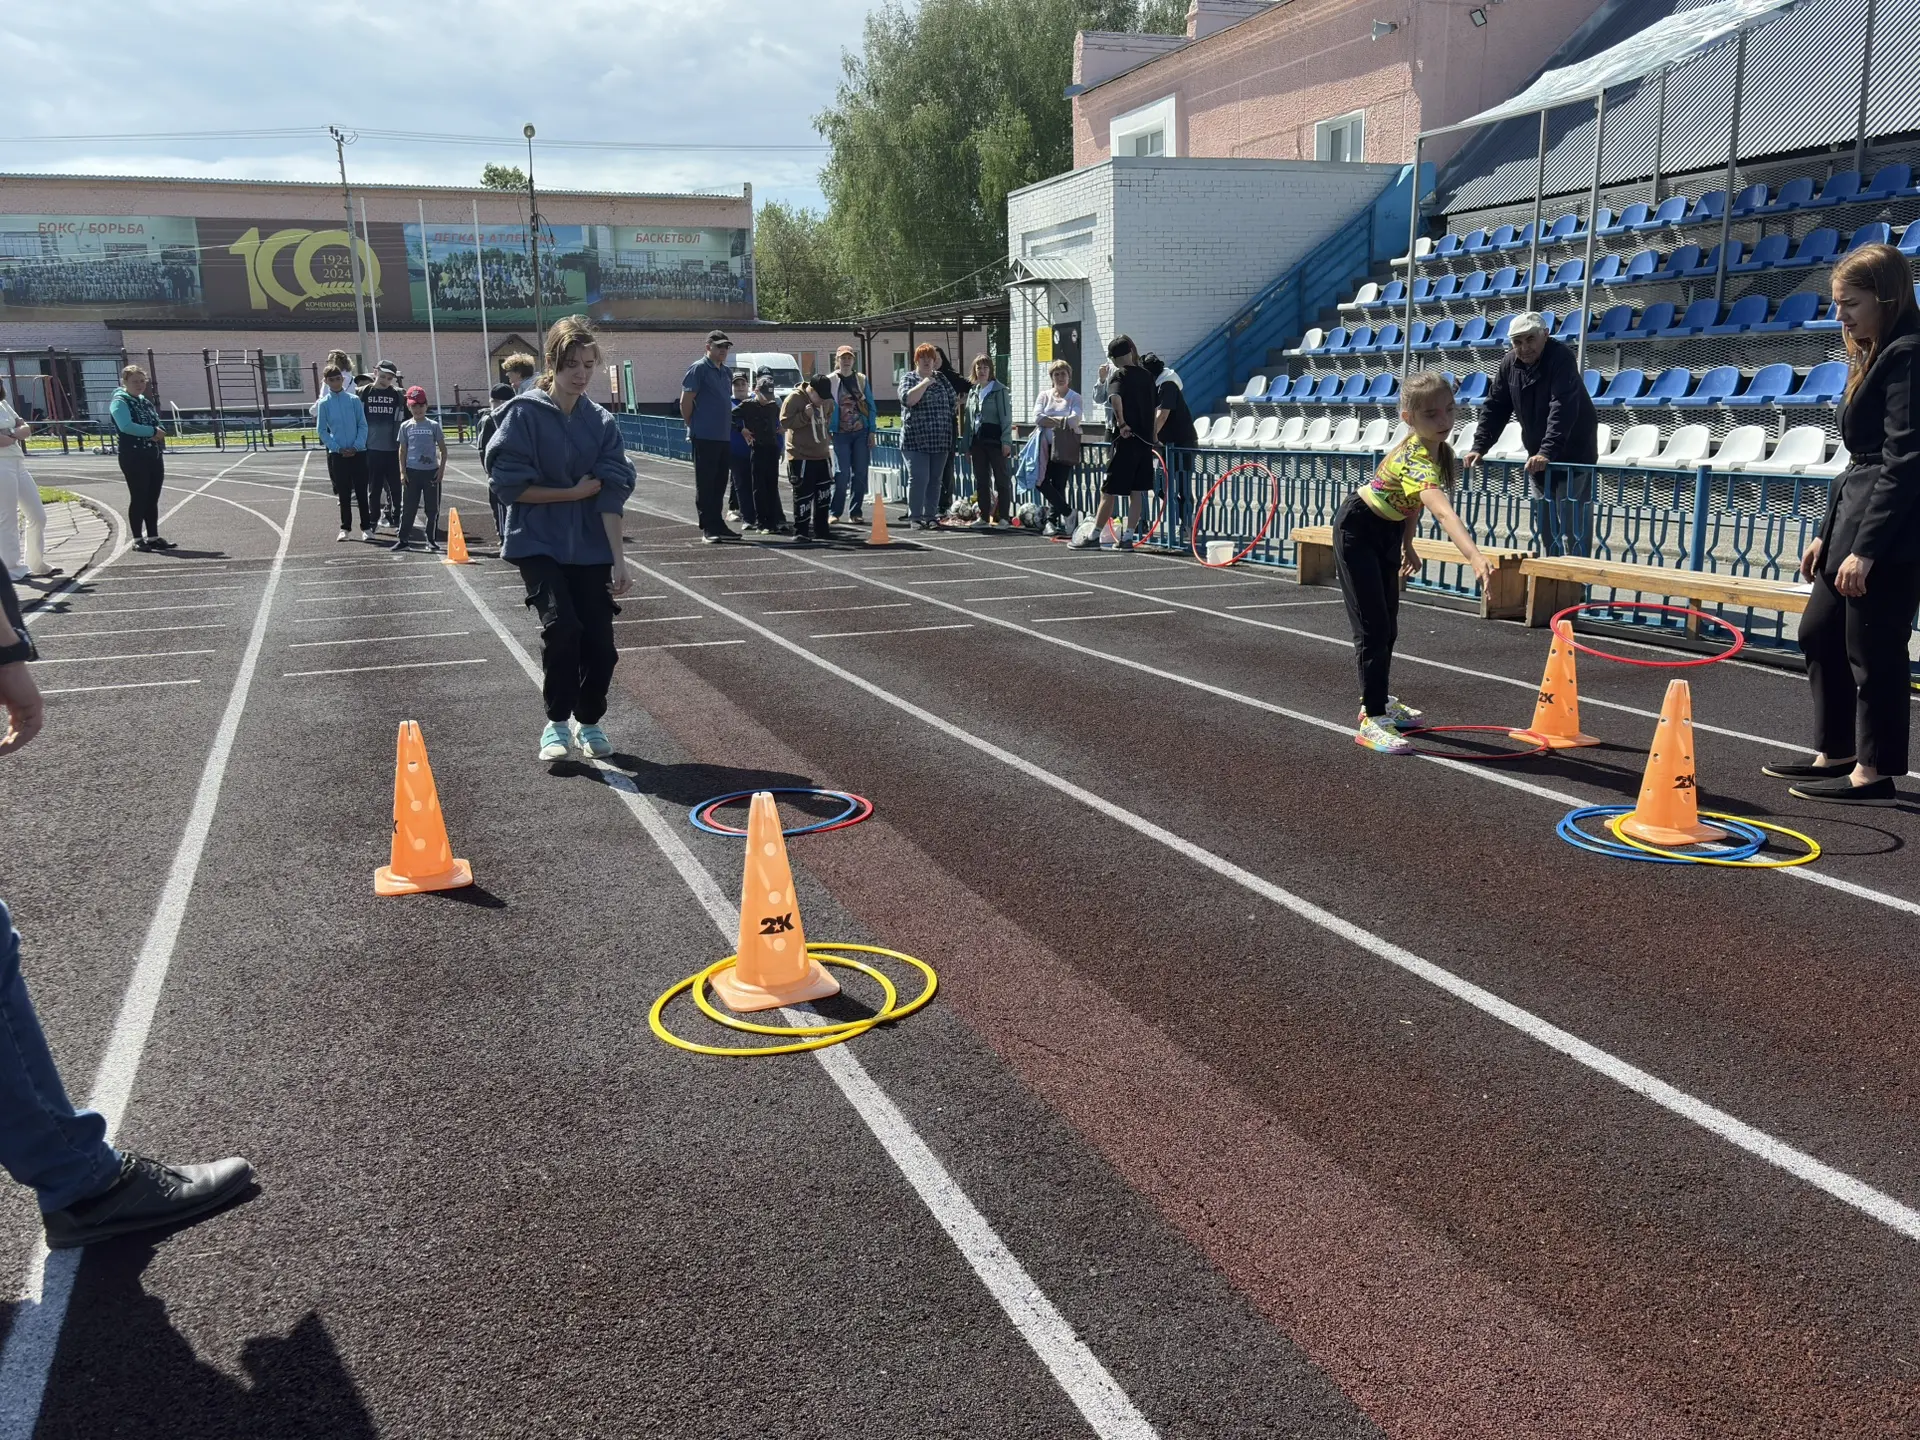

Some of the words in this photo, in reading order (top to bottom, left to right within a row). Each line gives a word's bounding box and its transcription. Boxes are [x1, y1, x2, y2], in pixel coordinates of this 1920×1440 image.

[38, 222, 76, 235] БОКС
[88, 223, 144, 235] БОРЬБА
[489, 234, 556, 244] АТЛЕТКА
[635, 232, 701, 244] БАСКЕТБОЛ
[322, 255, 350, 265] 1924
[323, 268, 351, 279] 2024
[367, 396, 394, 404] SLEEP
[368, 406, 394, 414] SQUAD
[758, 912, 795, 935] 2K
